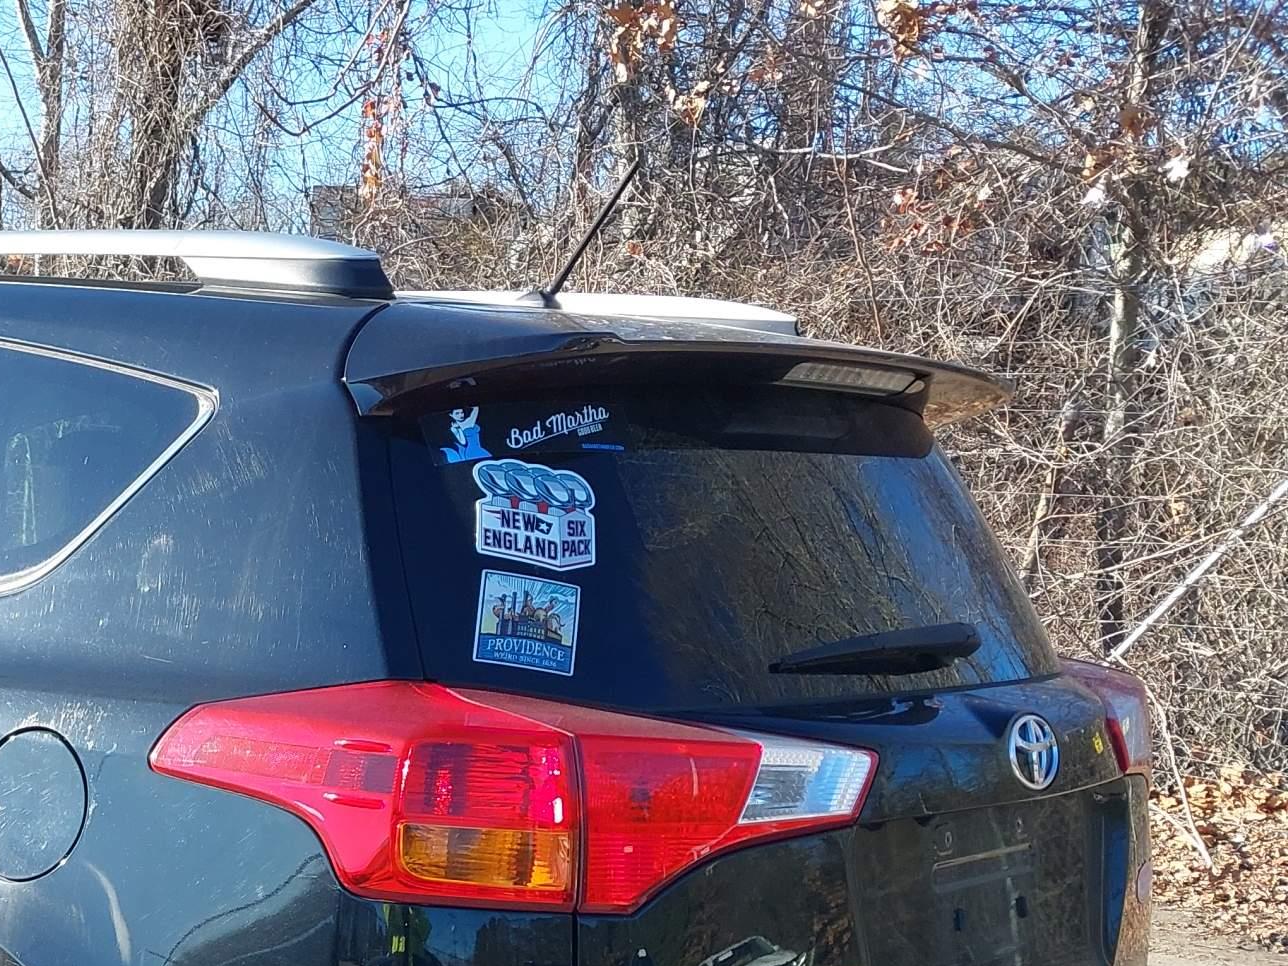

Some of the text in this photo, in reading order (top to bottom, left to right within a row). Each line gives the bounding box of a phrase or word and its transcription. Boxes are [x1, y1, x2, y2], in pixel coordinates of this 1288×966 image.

[506, 404, 610, 449] Bad Martha
[501, 509, 536, 533] NEW
[567, 519, 587, 537] SIX
[483, 528, 559, 560] ENGLAND
[562, 539, 592, 559] PACK
[486, 637, 566, 662] PROVIDENCE
